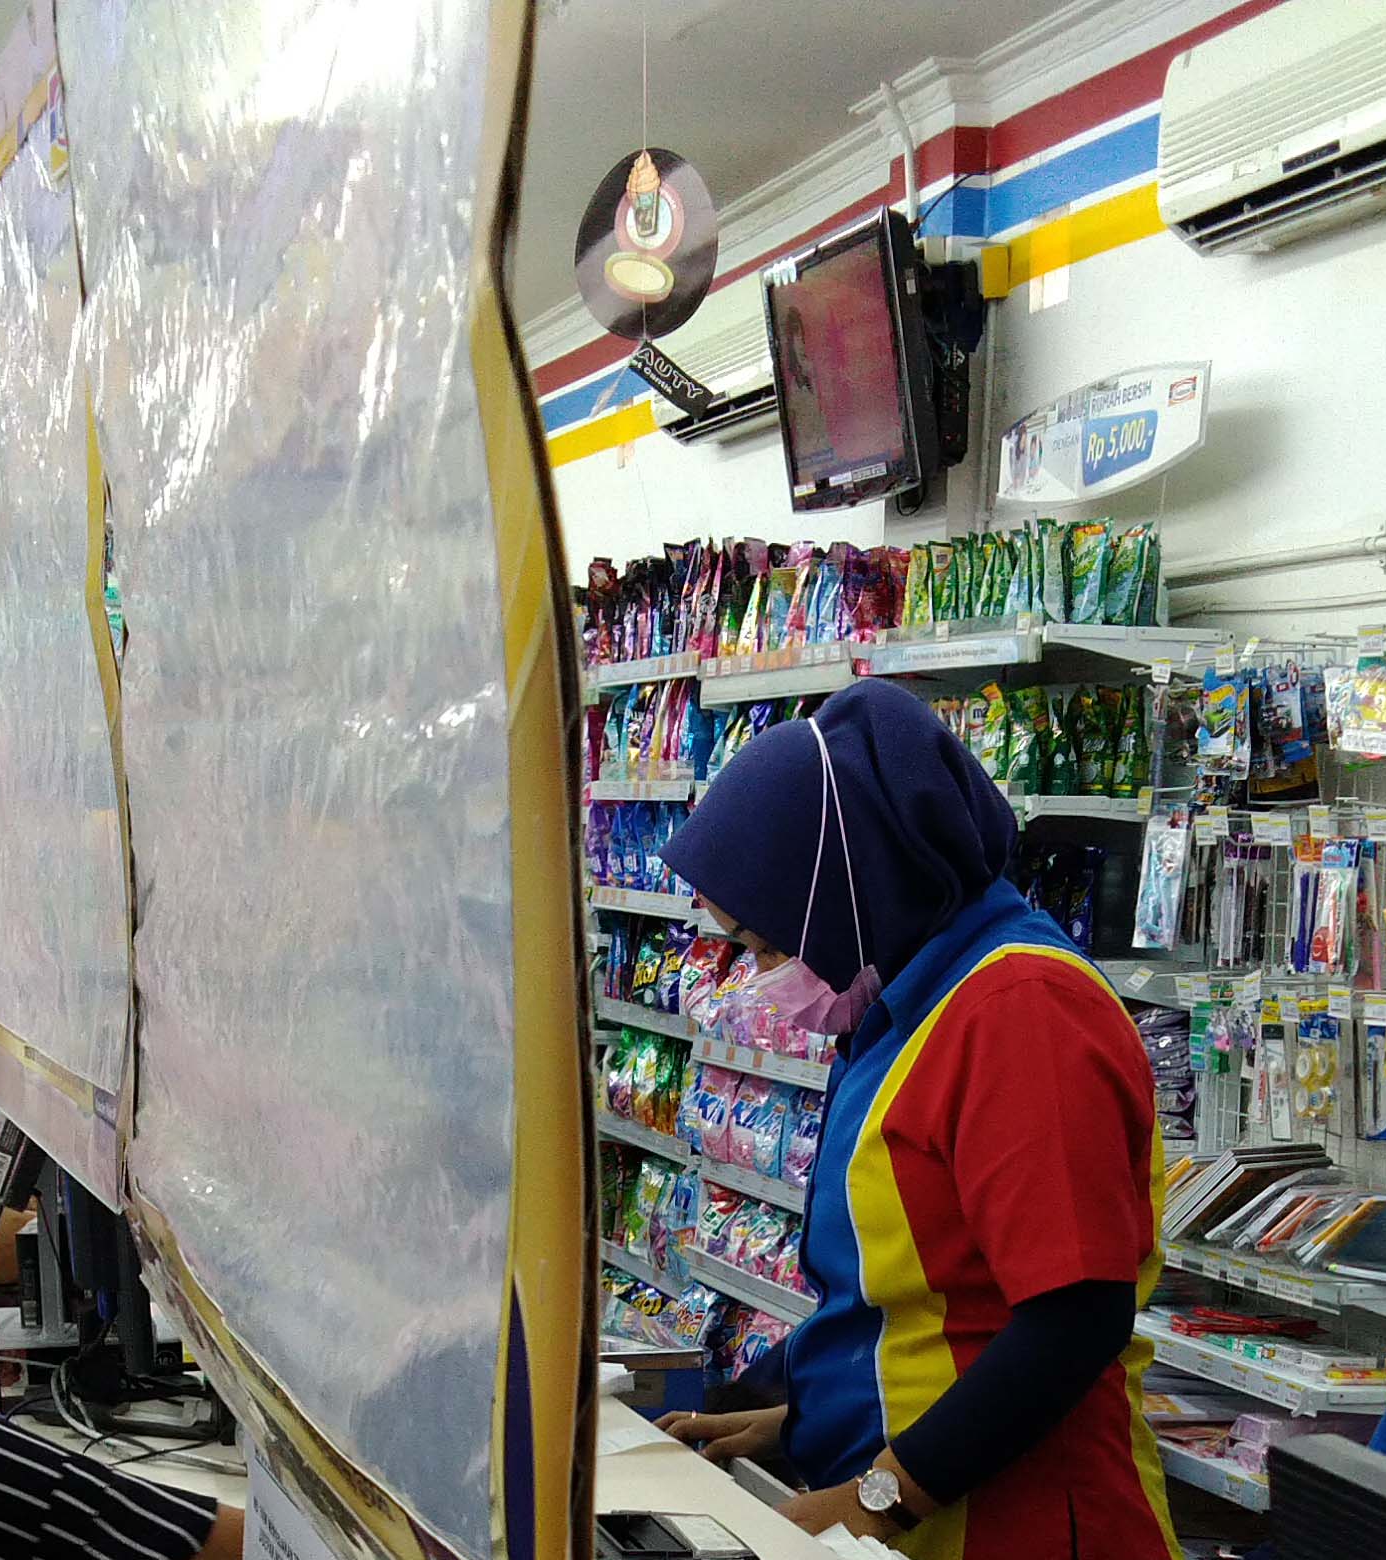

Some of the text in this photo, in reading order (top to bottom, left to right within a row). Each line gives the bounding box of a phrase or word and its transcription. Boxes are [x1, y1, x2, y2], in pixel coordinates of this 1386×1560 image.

[1123, 378, 1153, 406] BERSIH
[1086, 417, 1154, 470] Rp 5,000,-
